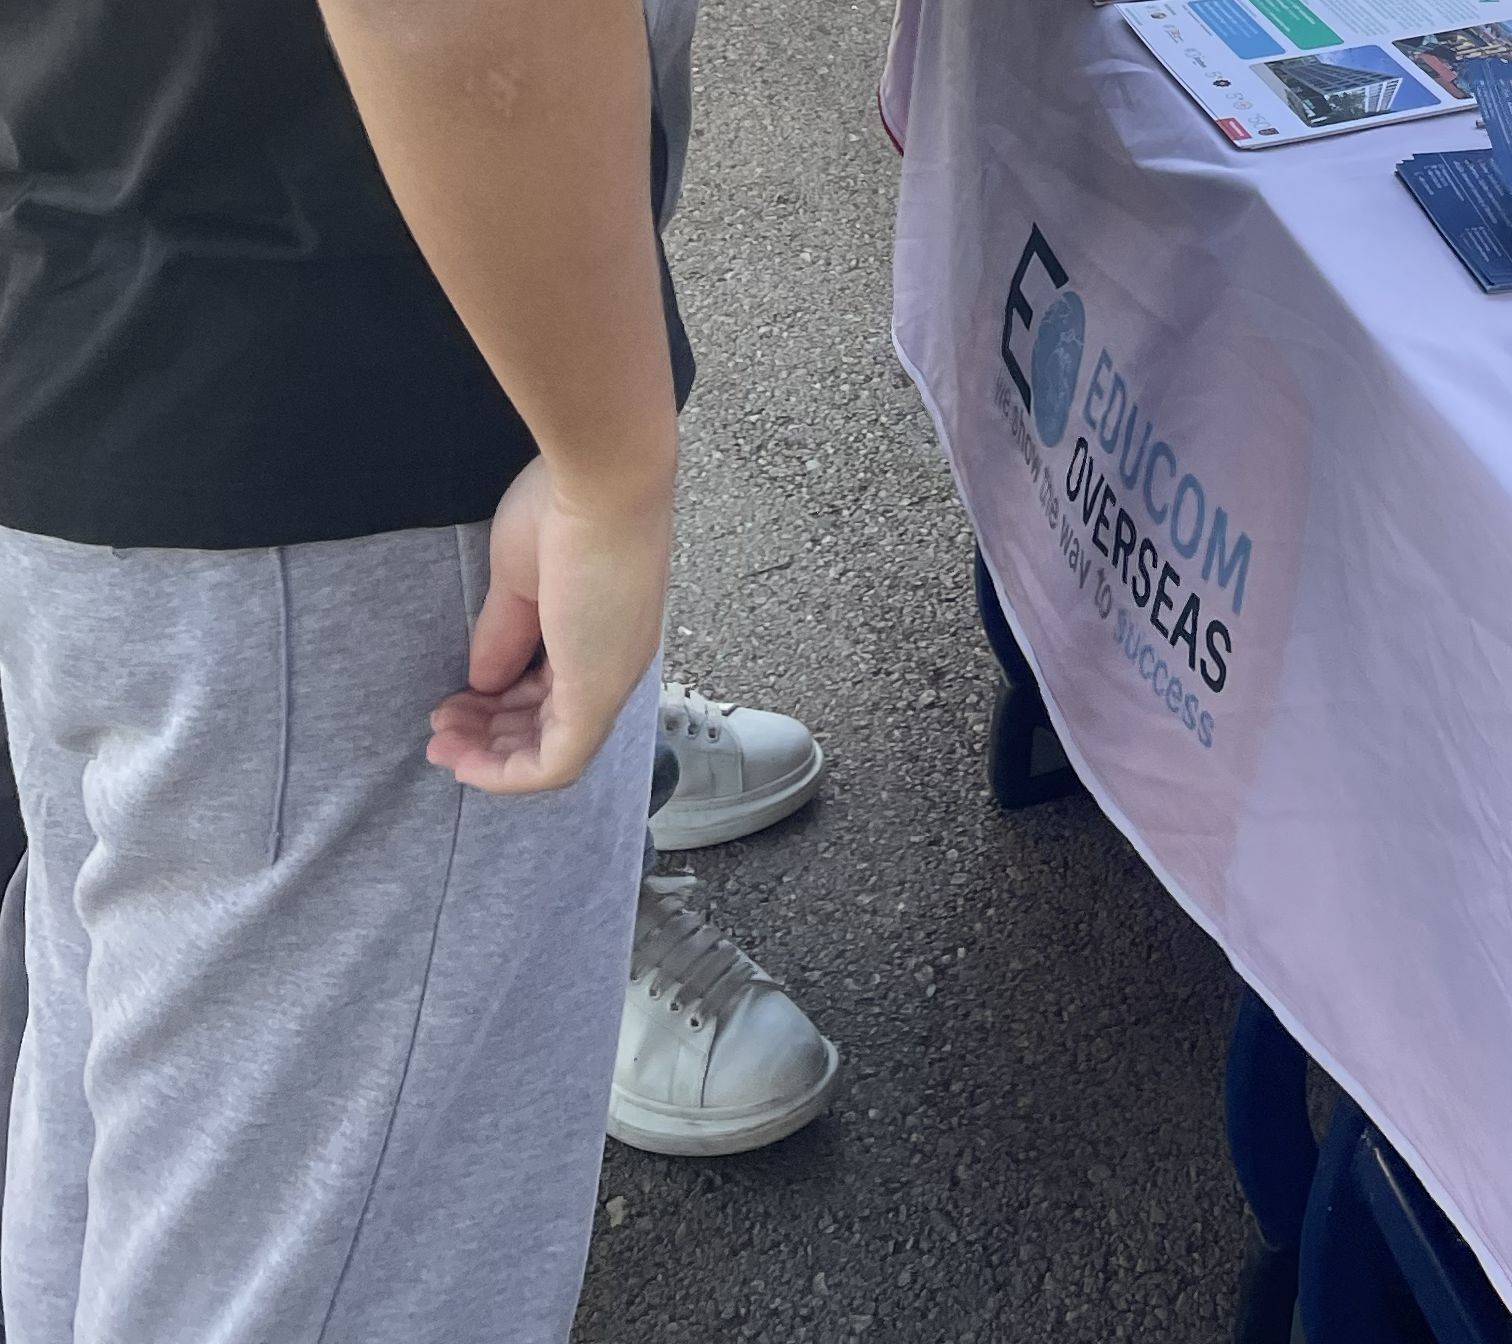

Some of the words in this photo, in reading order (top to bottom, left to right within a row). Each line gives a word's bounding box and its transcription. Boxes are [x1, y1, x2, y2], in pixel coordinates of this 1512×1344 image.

[1066, 436, 1233, 693] OVERSEAS
[1084, 347, 1253, 615] EDUCOM
[1059, 514, 1092, 590] way
[1096, 564, 1113, 620] to
[1112, 607, 1216, 750] success
